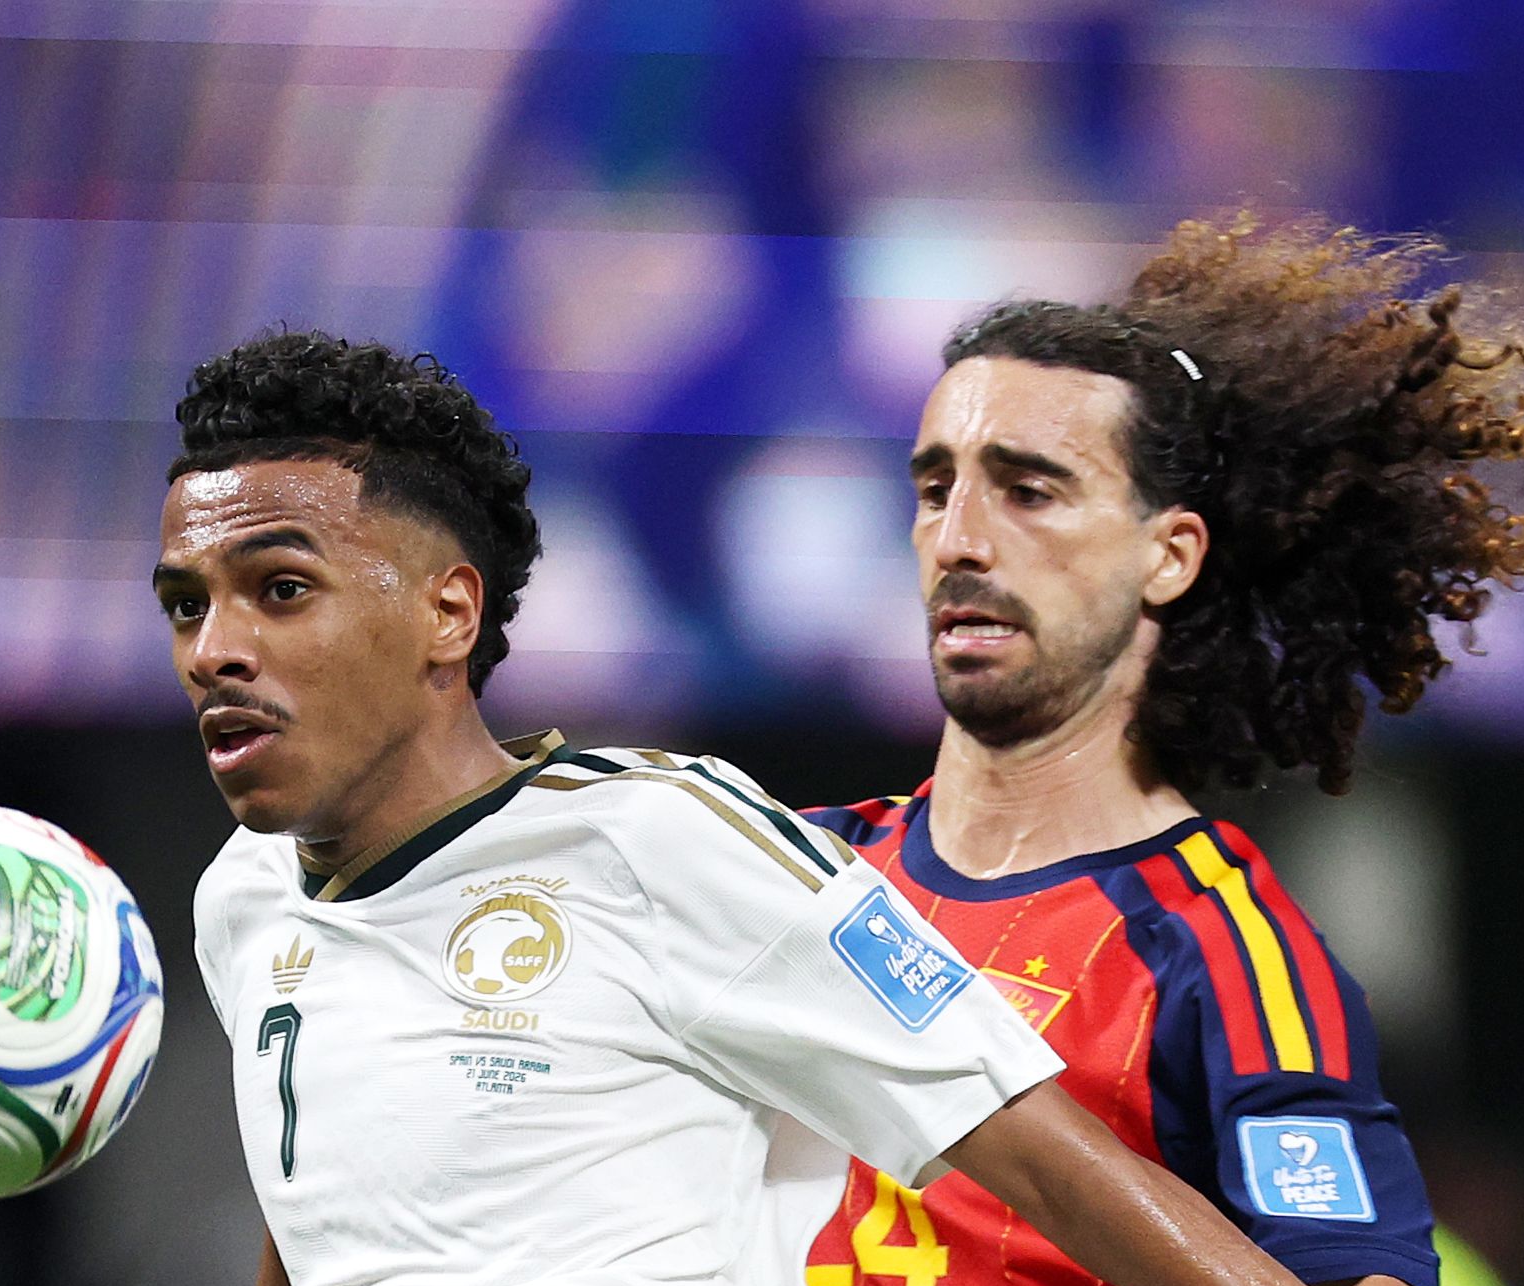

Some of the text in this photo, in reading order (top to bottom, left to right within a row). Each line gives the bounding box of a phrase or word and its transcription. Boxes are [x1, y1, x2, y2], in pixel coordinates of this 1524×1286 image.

[504, 956, 544, 968] SAFF
[901, 950, 948, 996] PEACE
[460, 1009, 540, 1032] SAUDI
[449, 1055, 551, 1075] SPAIN VS SAUDI ARABIA
[478, 1069, 499, 1080] JUNE
[503, 1071, 526, 1083] 2026
[257, 1003, 302, 1182] 7
[476, 1081, 514, 1094] ATLANTA
